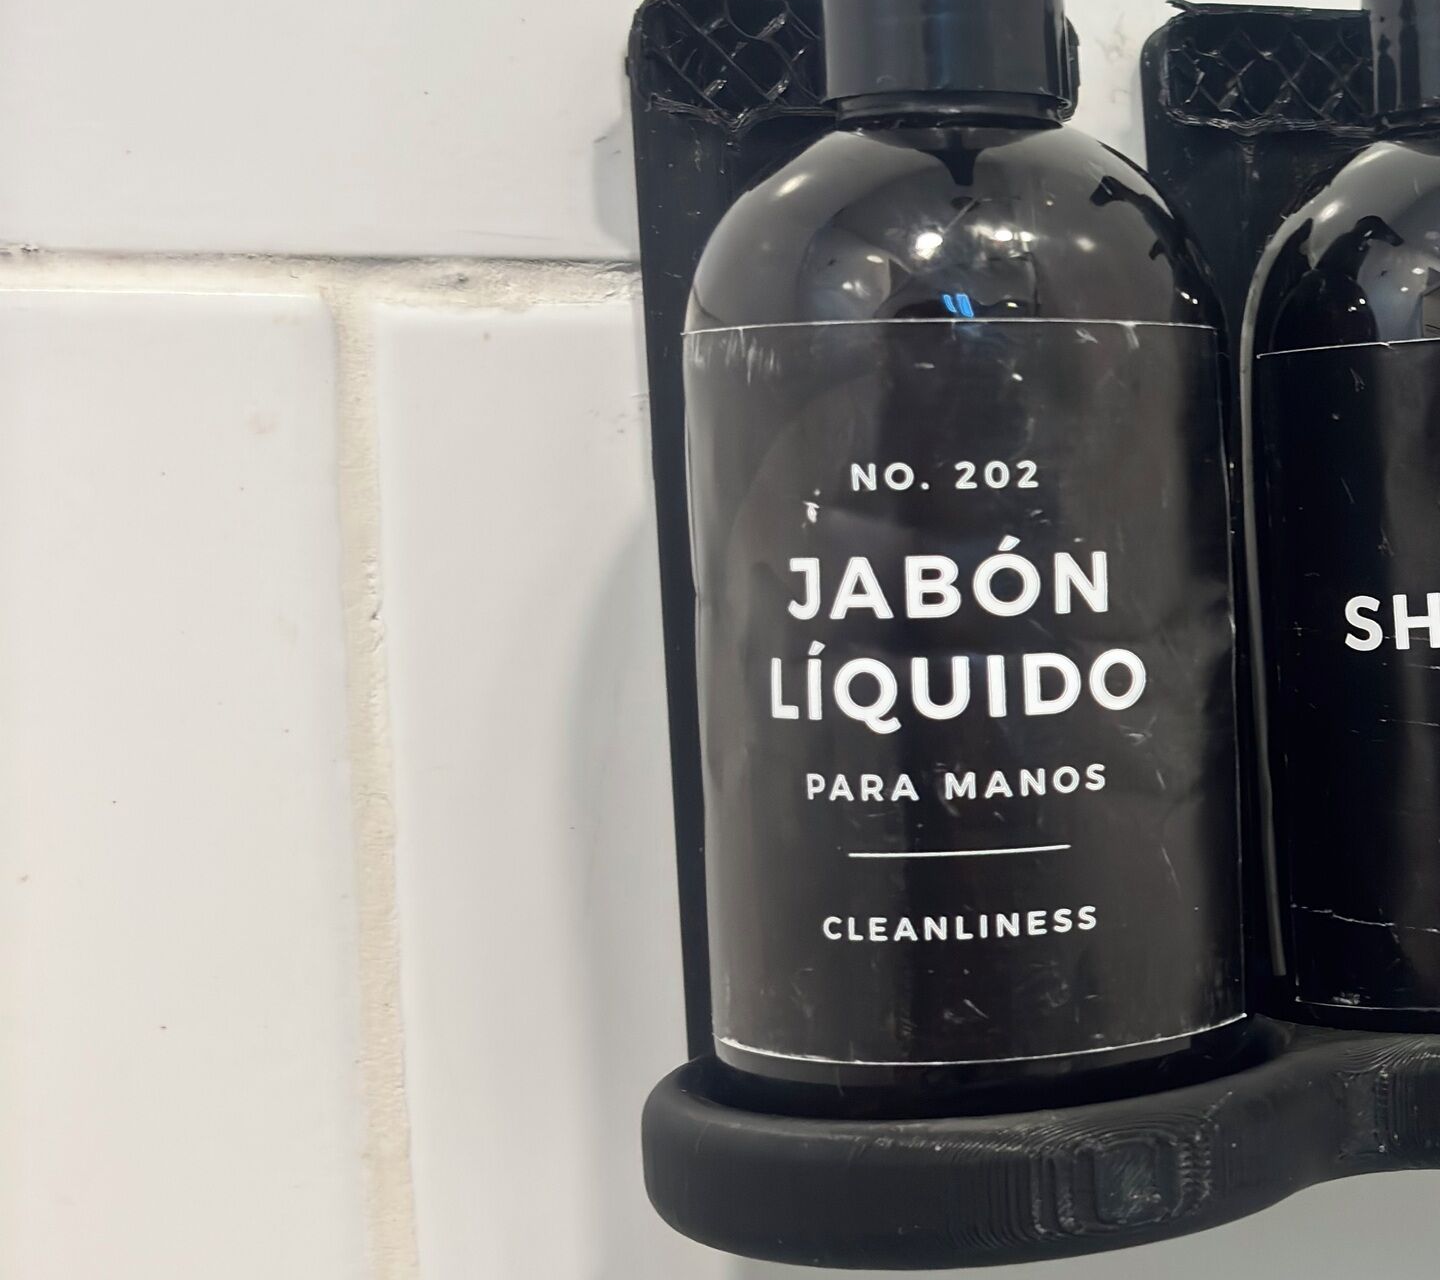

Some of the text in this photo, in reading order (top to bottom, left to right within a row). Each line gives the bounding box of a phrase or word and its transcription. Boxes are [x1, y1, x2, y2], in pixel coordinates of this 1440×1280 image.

[851, 460, 1039, 491] NO. 202
[788, 535, 1108, 620] JABÓN
[771, 640, 1146, 734] LÍQUIDO
[807, 763, 1107, 801] PARA MANOS
[823, 905, 1097, 941] CLEANLINESS
